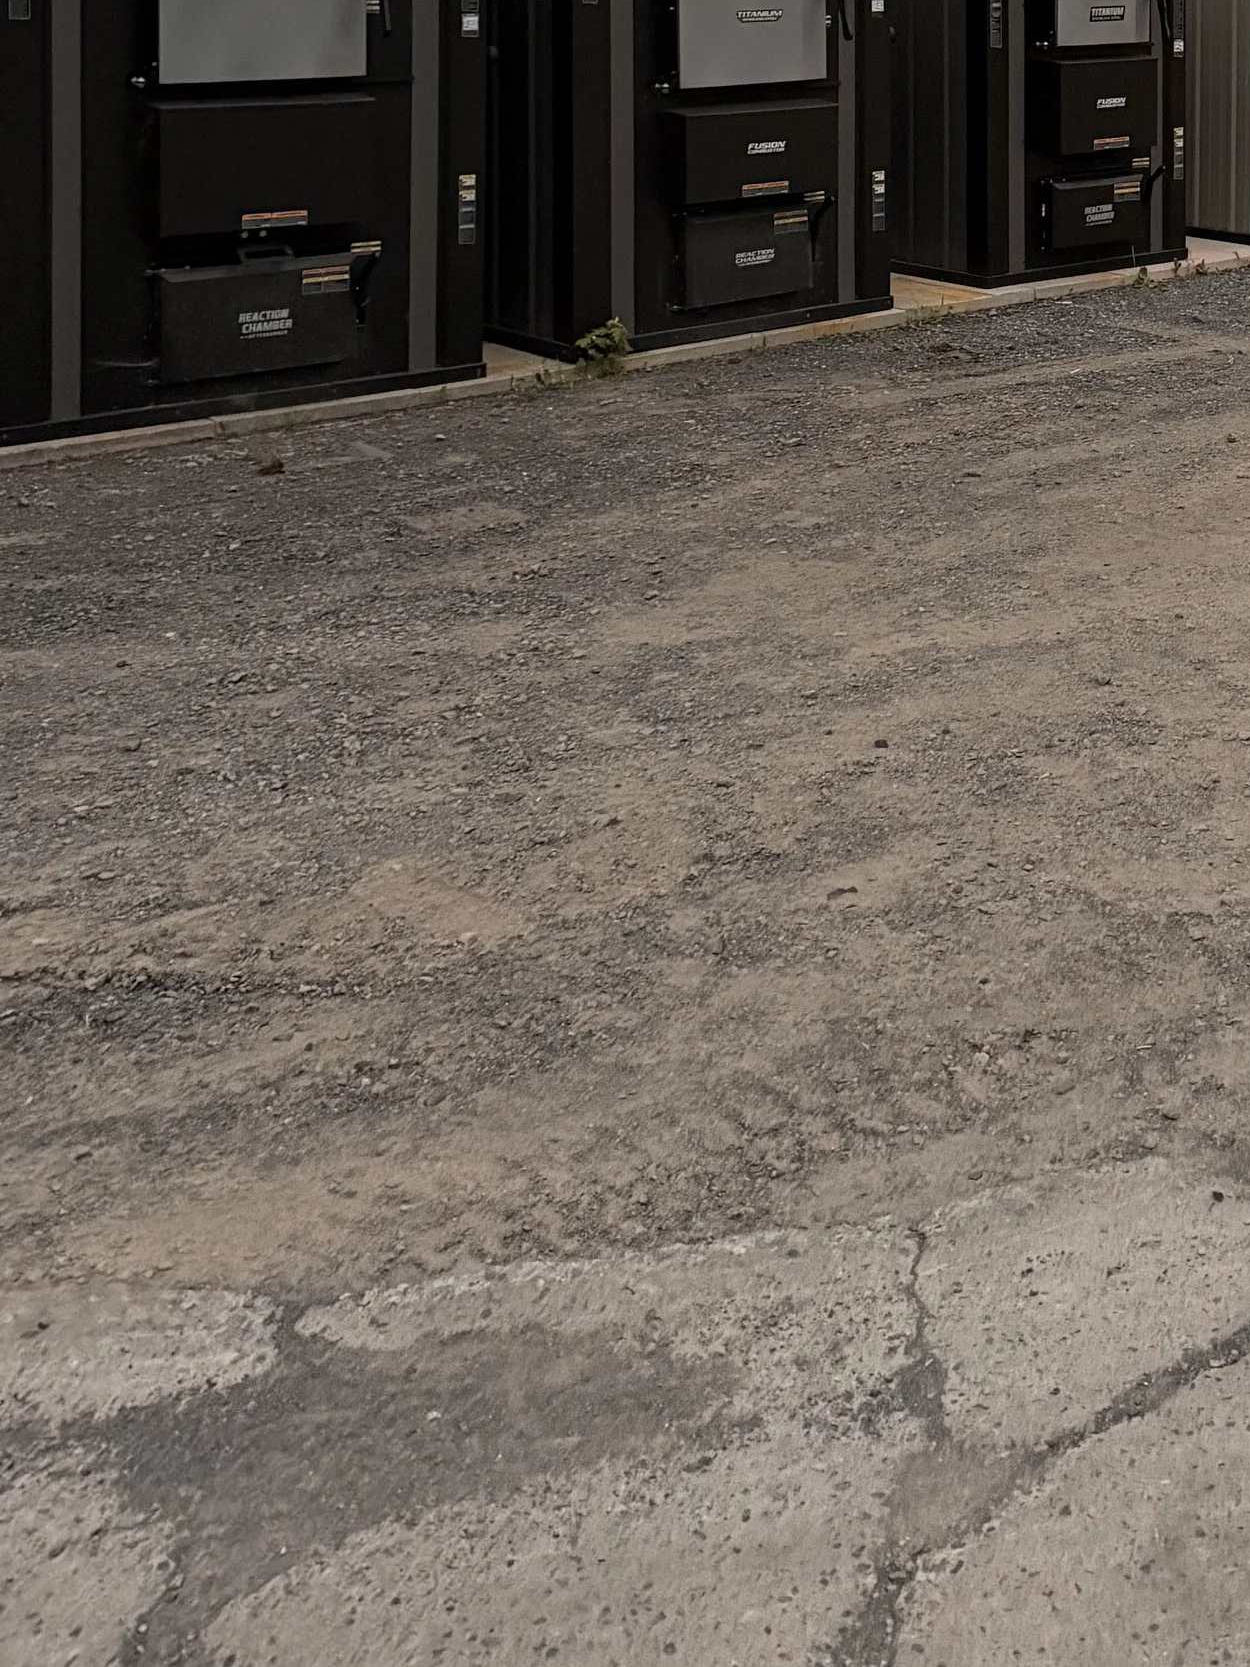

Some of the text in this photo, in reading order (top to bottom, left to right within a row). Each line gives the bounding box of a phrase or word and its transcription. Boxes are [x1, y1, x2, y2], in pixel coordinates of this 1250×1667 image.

[737, 10, 783, 19] TITANIUM
[1092, 7, 1124, 16] TITANIUM
[748, 141, 786, 150] FUSION
[735, 248, 775, 259] REACTION
[735, 253, 775, 265] CHAMBER
[238, 308, 290, 324] REACTION
[241, 319, 293, 334] CHAMBER
